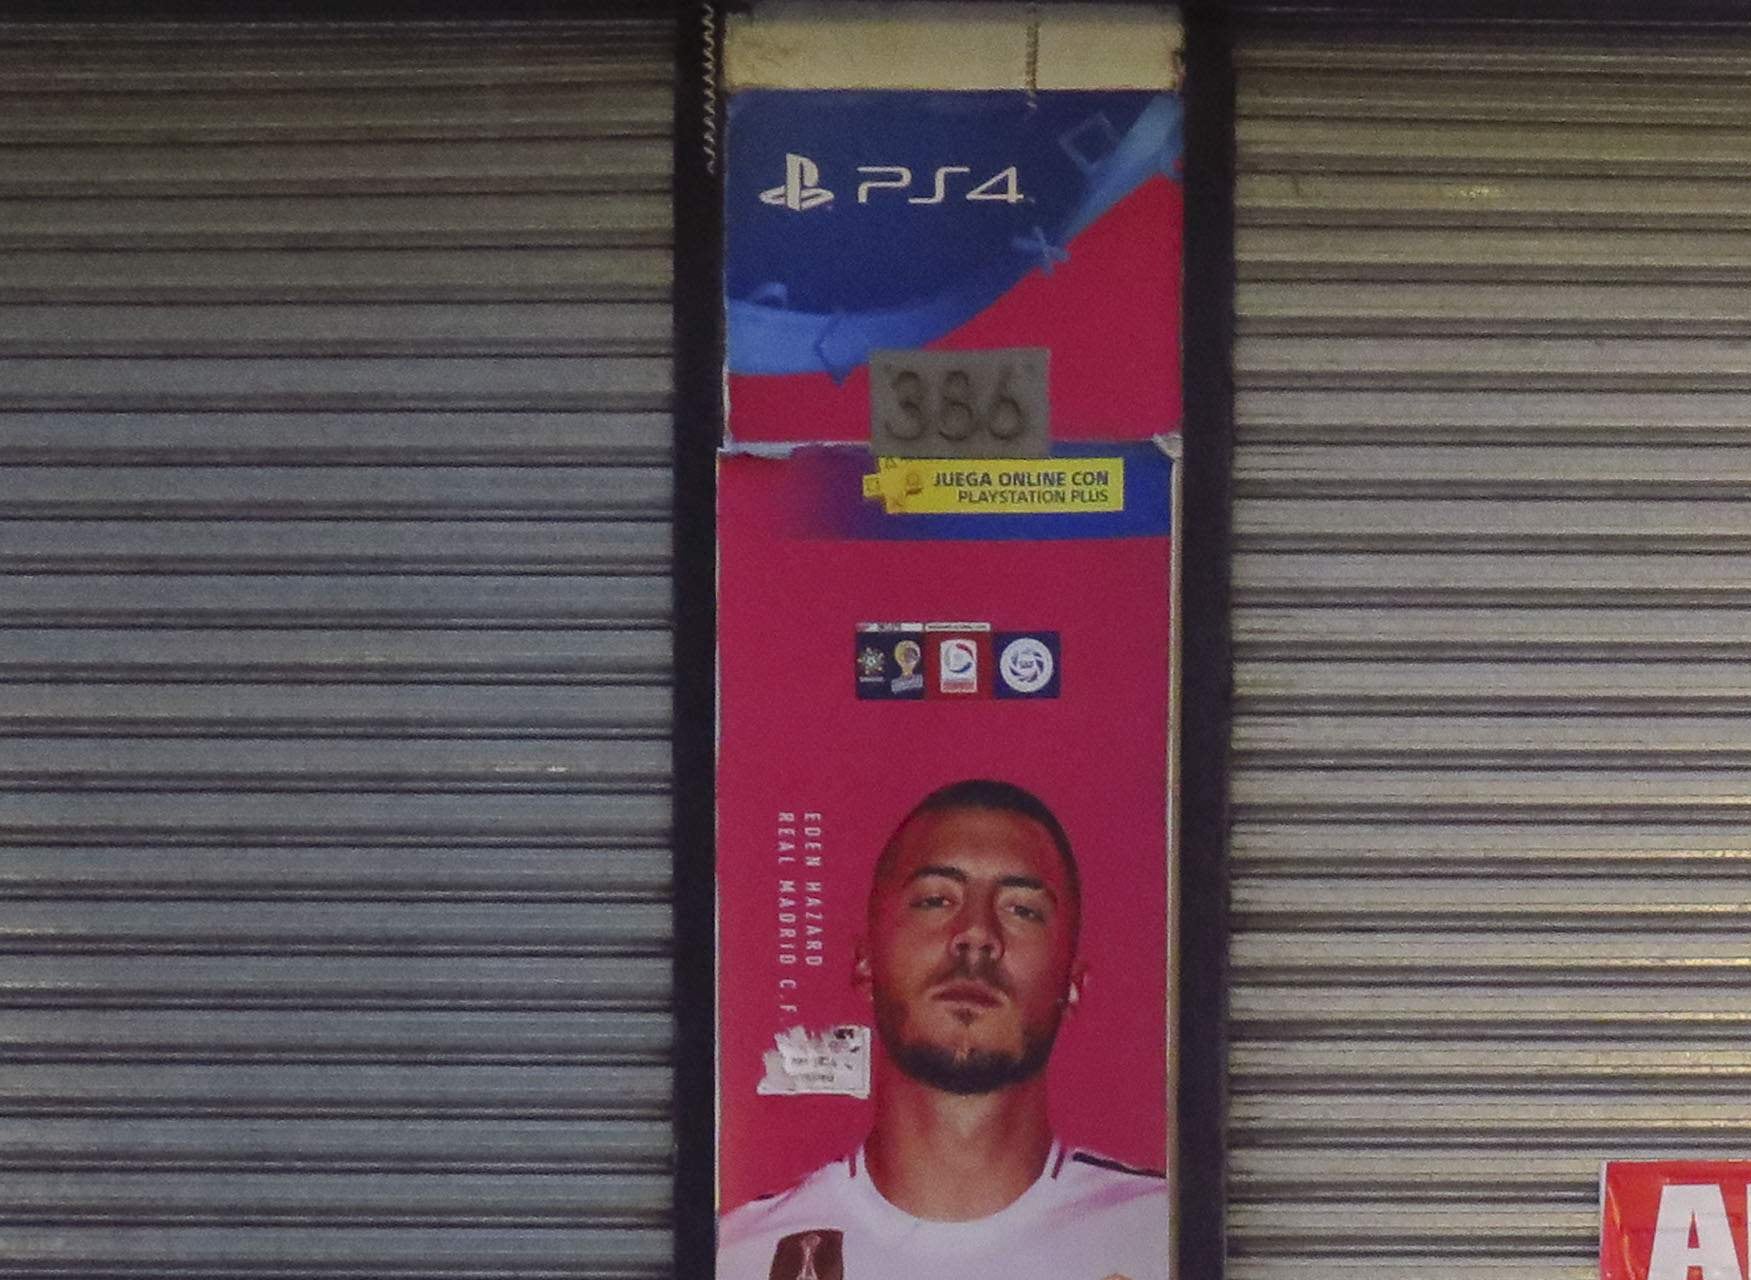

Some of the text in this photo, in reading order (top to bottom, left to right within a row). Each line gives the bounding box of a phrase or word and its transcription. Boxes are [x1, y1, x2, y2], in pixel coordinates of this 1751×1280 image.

[856, 164, 1025, 205] PS4
[884, 366, 1025, 442] 386
[933, 470, 1109, 487] JUEGA ONLINE CON
[957, 488, 1109, 504] PLAYSTATION PLUS
[777, 811, 796, 865] REAL
[804, 811, 823, 967] EDEN HAZARD
[778, 880, 797, 966] MADRID
